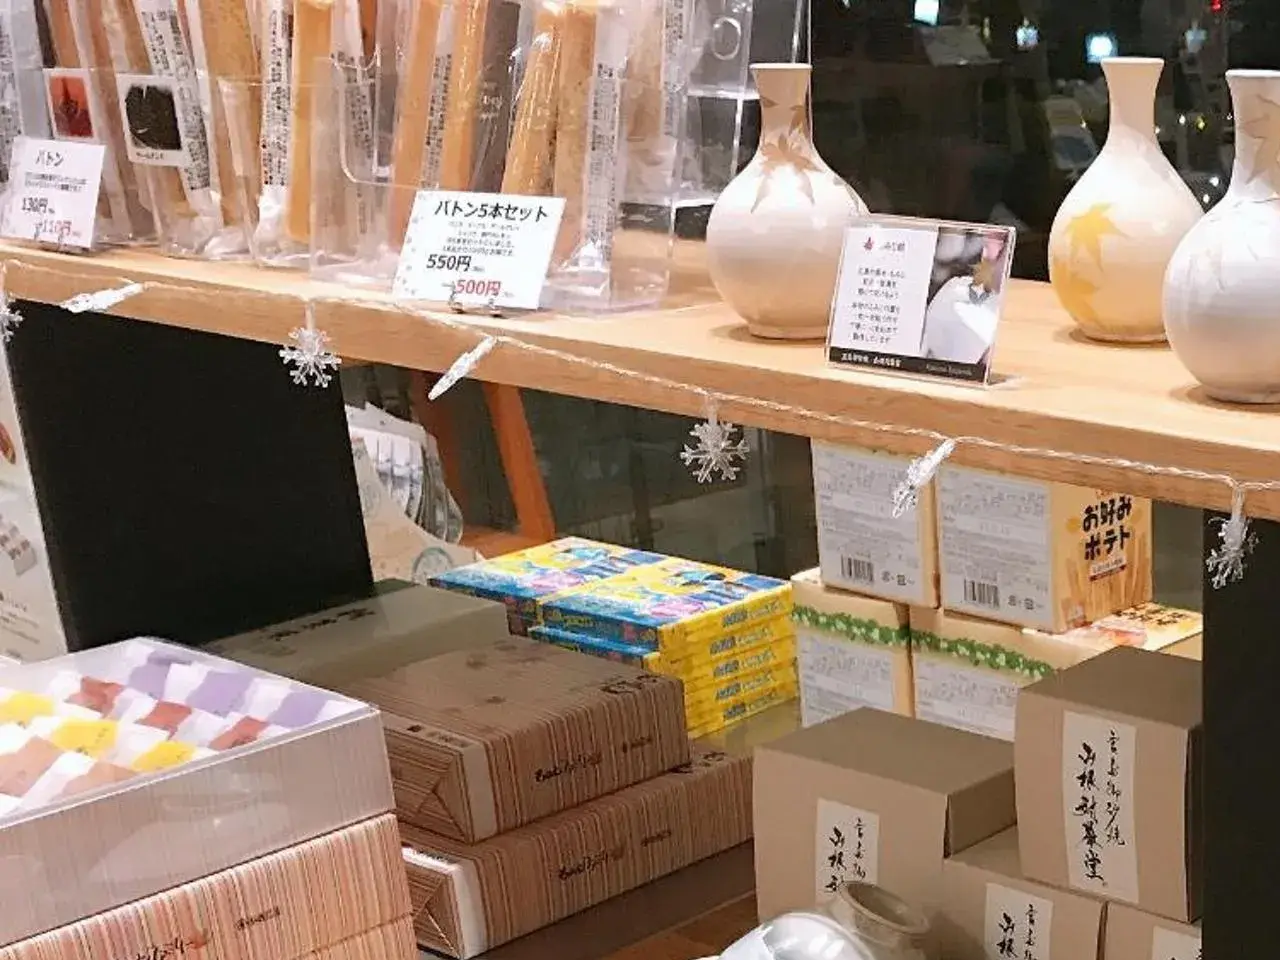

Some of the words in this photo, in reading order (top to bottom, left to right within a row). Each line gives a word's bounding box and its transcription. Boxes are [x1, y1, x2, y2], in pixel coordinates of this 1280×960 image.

[434, 201, 548, 223] バトン5本セット
[426, 254, 472, 273] 550円
[455, 279, 502, 297] 500円
[1083, 496, 1132, 532] お好み
[1085, 526, 1131, 560] ポテト
